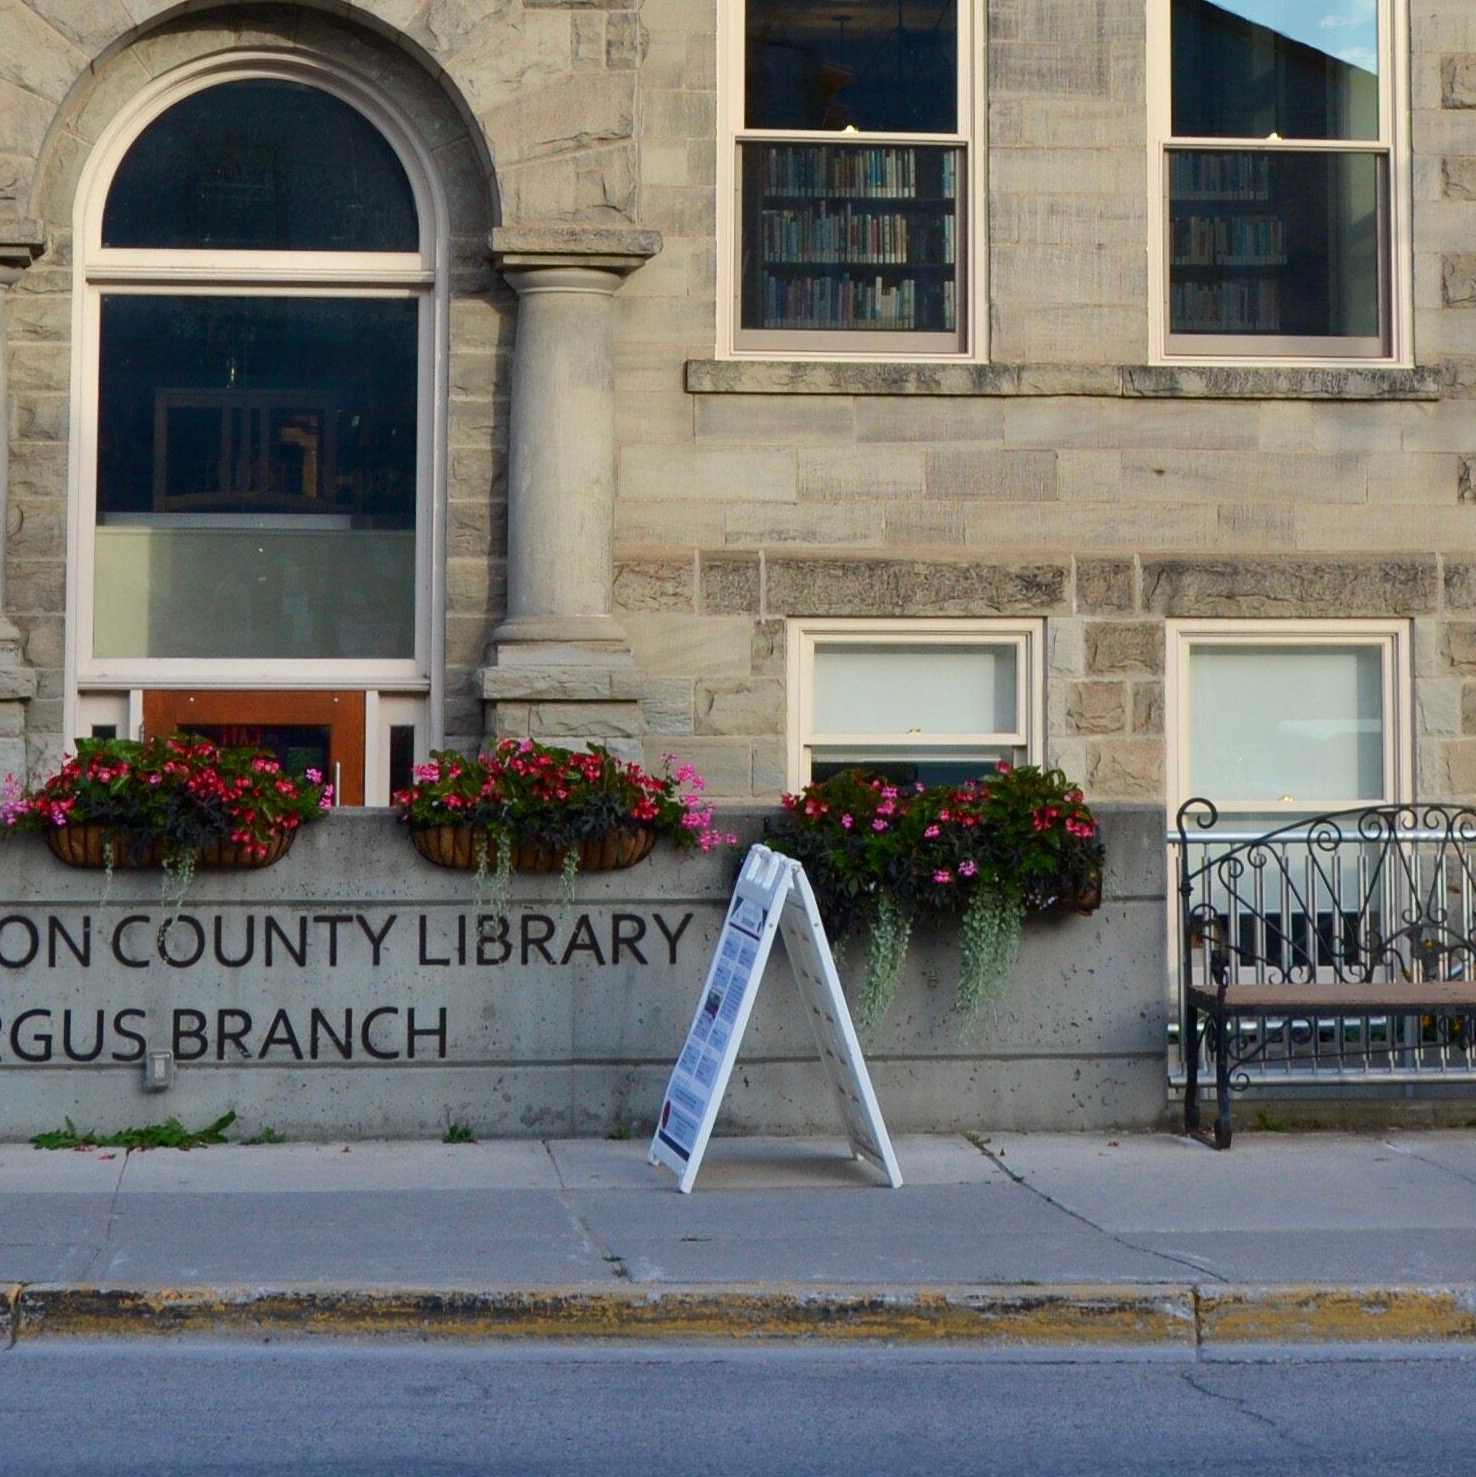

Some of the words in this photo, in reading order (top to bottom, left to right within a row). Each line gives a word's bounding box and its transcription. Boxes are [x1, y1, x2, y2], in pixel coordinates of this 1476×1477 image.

[111, 913, 398, 968] COUNTY
[419, 912, 695, 966] LIBRARY
[173, 1006, 447, 1060] BRANCH
